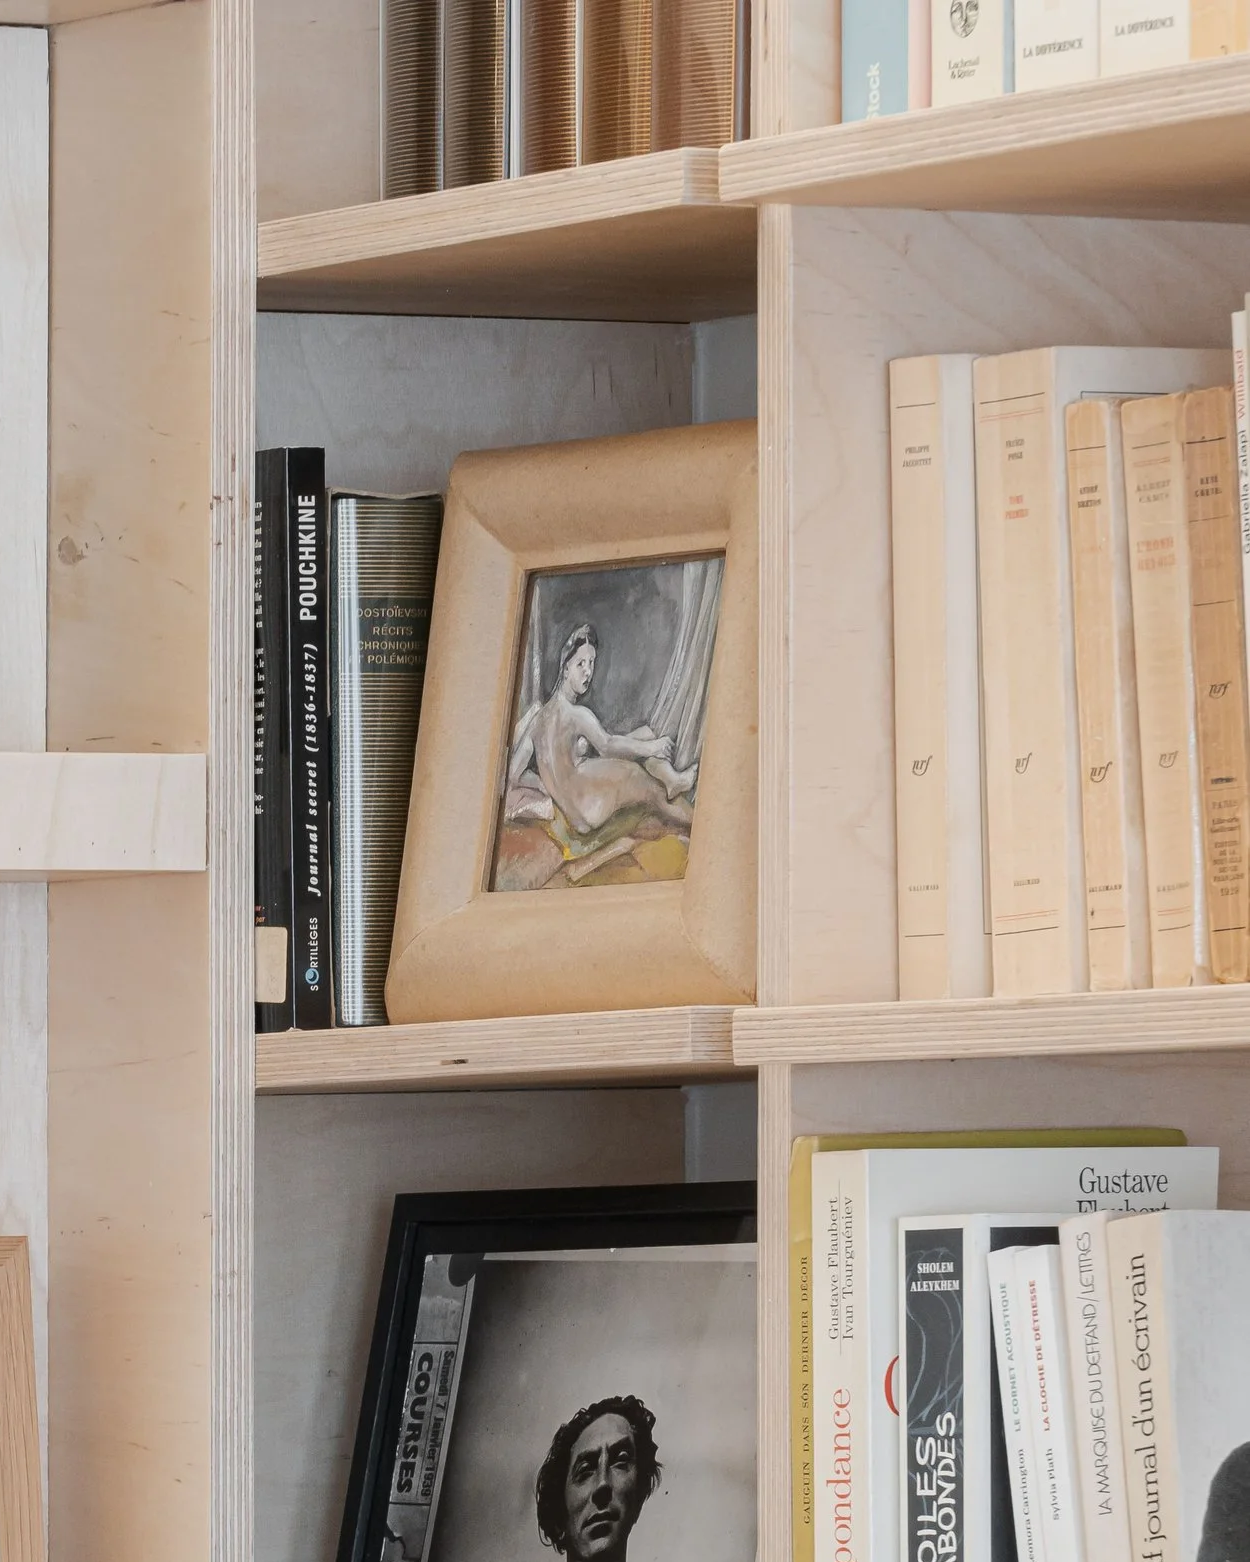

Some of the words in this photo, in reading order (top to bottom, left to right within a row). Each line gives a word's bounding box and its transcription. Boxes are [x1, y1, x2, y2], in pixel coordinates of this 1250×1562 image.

[1023, 47, 1033, 58] LA
[1038, 38, 1084, 56] DIFFÉRENCE
[1236, 350, 1245, 418] Willibald
[298, 495, 317, 621] POUCHKINE
[358, 641, 420, 652] CHRONIQUE
[372, 623, 413, 636] RÉCITS
[367, 652, 422, 666] POLÉMIQU
[302, 643, 319, 752] (1836-1837)
[306, 760, 318, 817] secret
[306, 824, 322, 897] Journal
[1079, 1167, 1168, 1194] Gustave
[827, 1196, 838, 1268] Flaubert
[842, 1196, 856, 1298] Tourguéniev
[800, 1256, 808, 1302] DÉCOR
[910, 1280, 960, 1292] ALEYKHEM
[916, 1262, 954, 1274] SHOLEM
[828, 1272, 839, 1340] Gustave
[842, 1306, 854, 1340] Ivan
[1001, 1282, 1015, 1362] ACOUSTIQUE
[1028, 1279, 1042, 1342] DÉTRESSE
[1126, 1253, 1152, 1372] écrivain
[802, 1310, 810, 1374] DERNIER
[1036, 1344, 1043, 1360] DE
[1083, 1303, 1102, 1376] DEFFAND
[438, 1350, 454, 1396] Samedi
[1010, 1367, 1020, 1414] CORNET
[1038, 1363, 1048, 1412] CLOCHE
[1090, 1380, 1104, 1403] DU
[396, 1352, 434, 1494] COURSES
[436, 1402, 446, 1412] 7
[1014, 1416, 1022, 1432] LE
[1043, 1416, 1050, 1432] LA
[1132, 1378, 1155, 1436] d'un
[425, 1416, 444, 1460] Janvier
[802, 1416, 810, 1452] DANS
[1092, 1406, 1110, 1494] MARQUISE
[420, 1464, 436, 1497] 1939
[1018, 1448, 1030, 1516] Carrington
[1046, 1448, 1055, 1480] Plath
[802, 1470, 811, 1524] GAUGUIN
[1050, 1483, 1061, 1520] Sylvia
[1098, 1498, 1112, 1516] LA
[1134, 1443, 1167, 1540] journal
